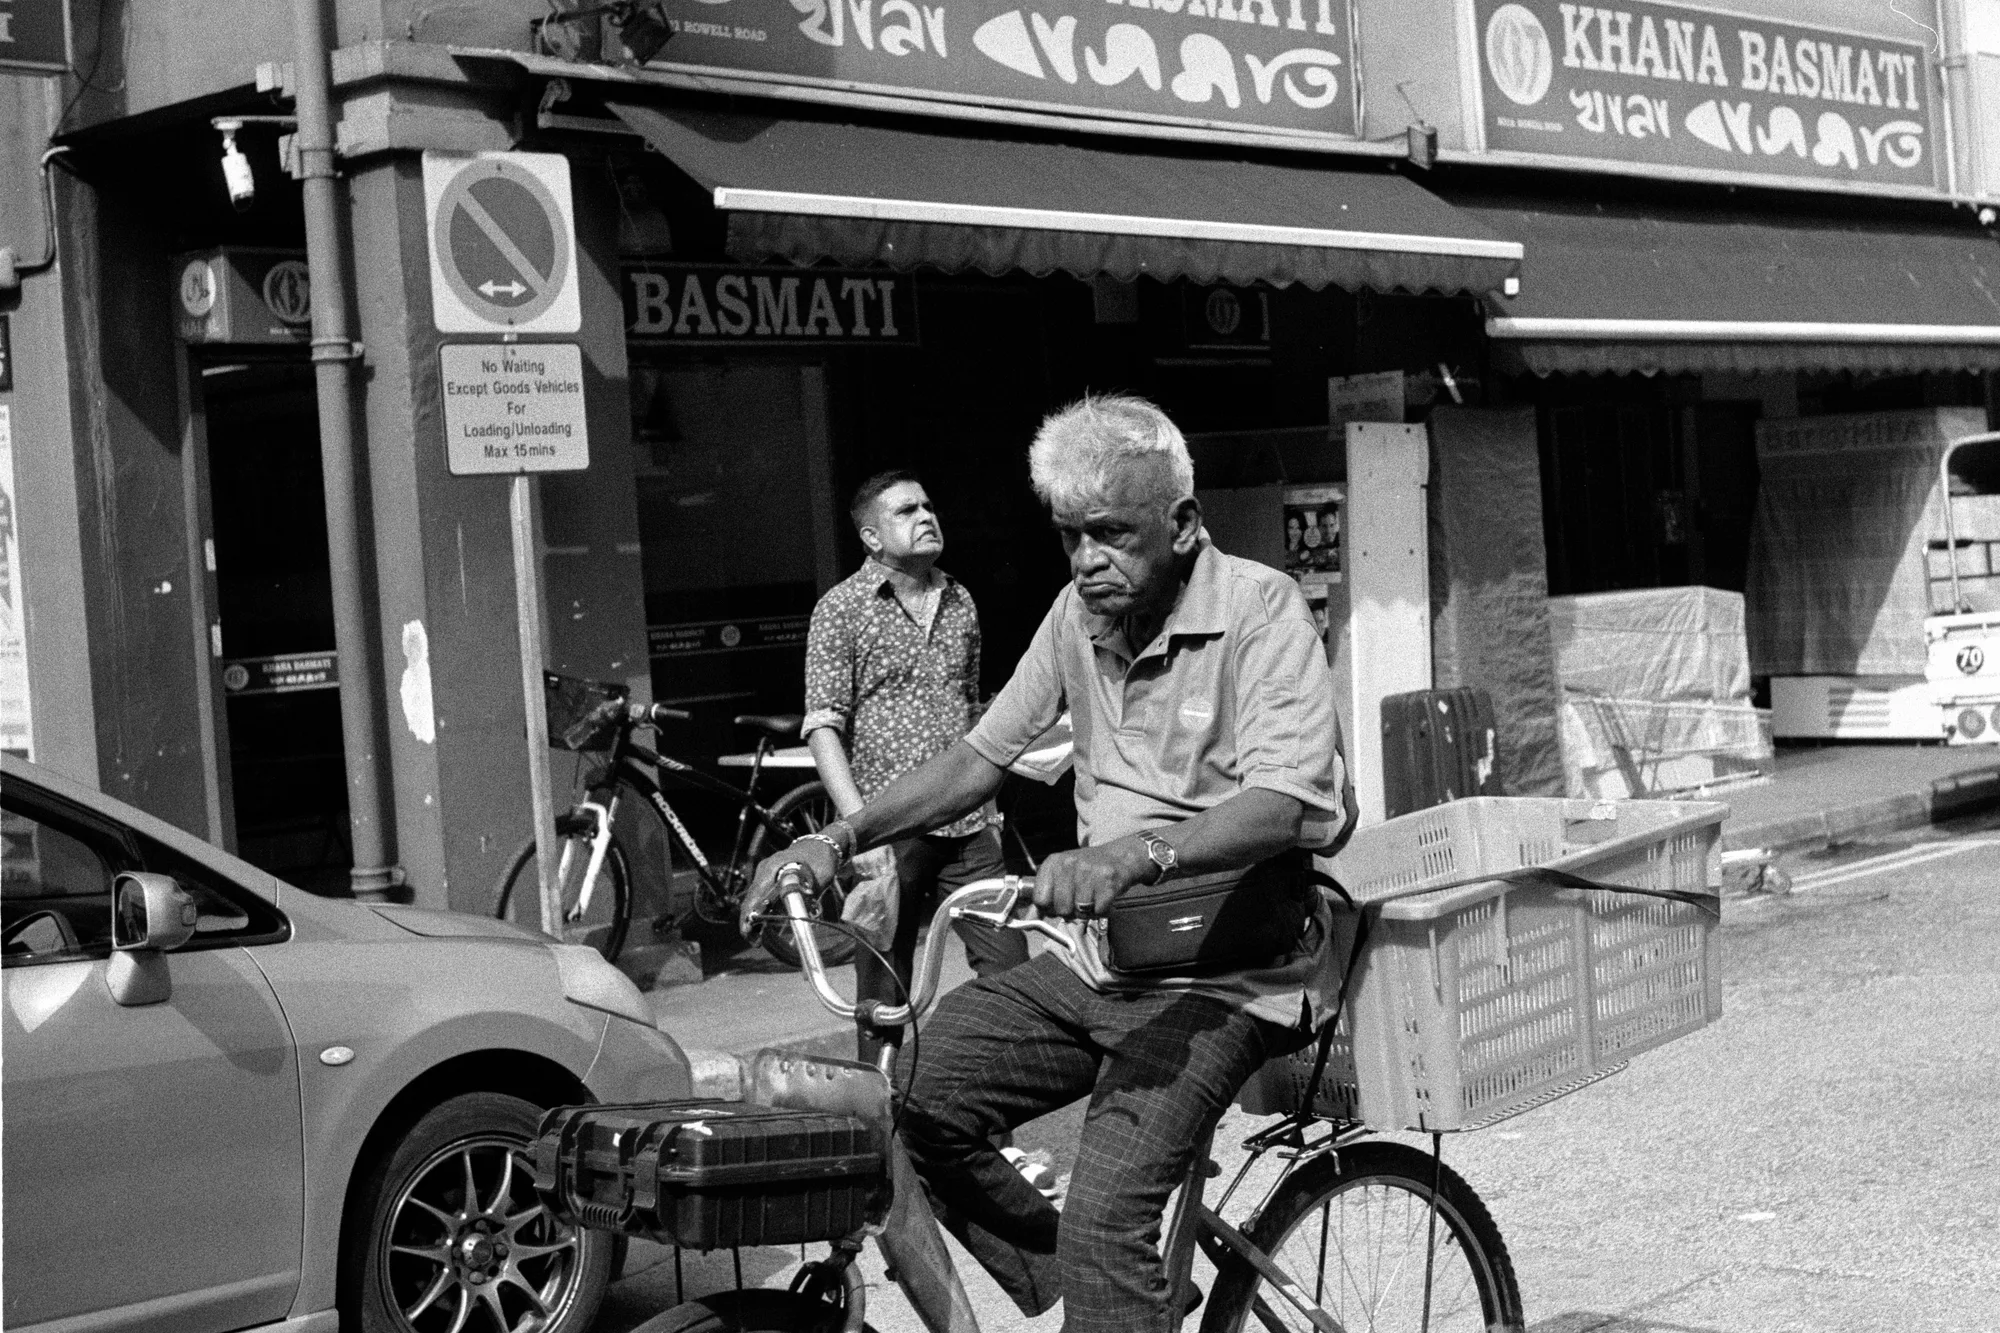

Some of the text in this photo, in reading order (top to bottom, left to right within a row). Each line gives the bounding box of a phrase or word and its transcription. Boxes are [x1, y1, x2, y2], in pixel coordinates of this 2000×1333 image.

[734, 26, 768, 41] ROAD
[1559, 3, 1920, 110] KHANA BASMATI
[630, 272, 899, 337] BASMATI
[482, 359, 545, 375] No Waiting
[447, 379, 580, 398] Except Goods Vehicles
[507, 401, 526, 416] For
[463, 421, 572, 440] Loading/Unloading
[484, 444, 509, 459] Max
[1959, 648, 1982, 668] 70
